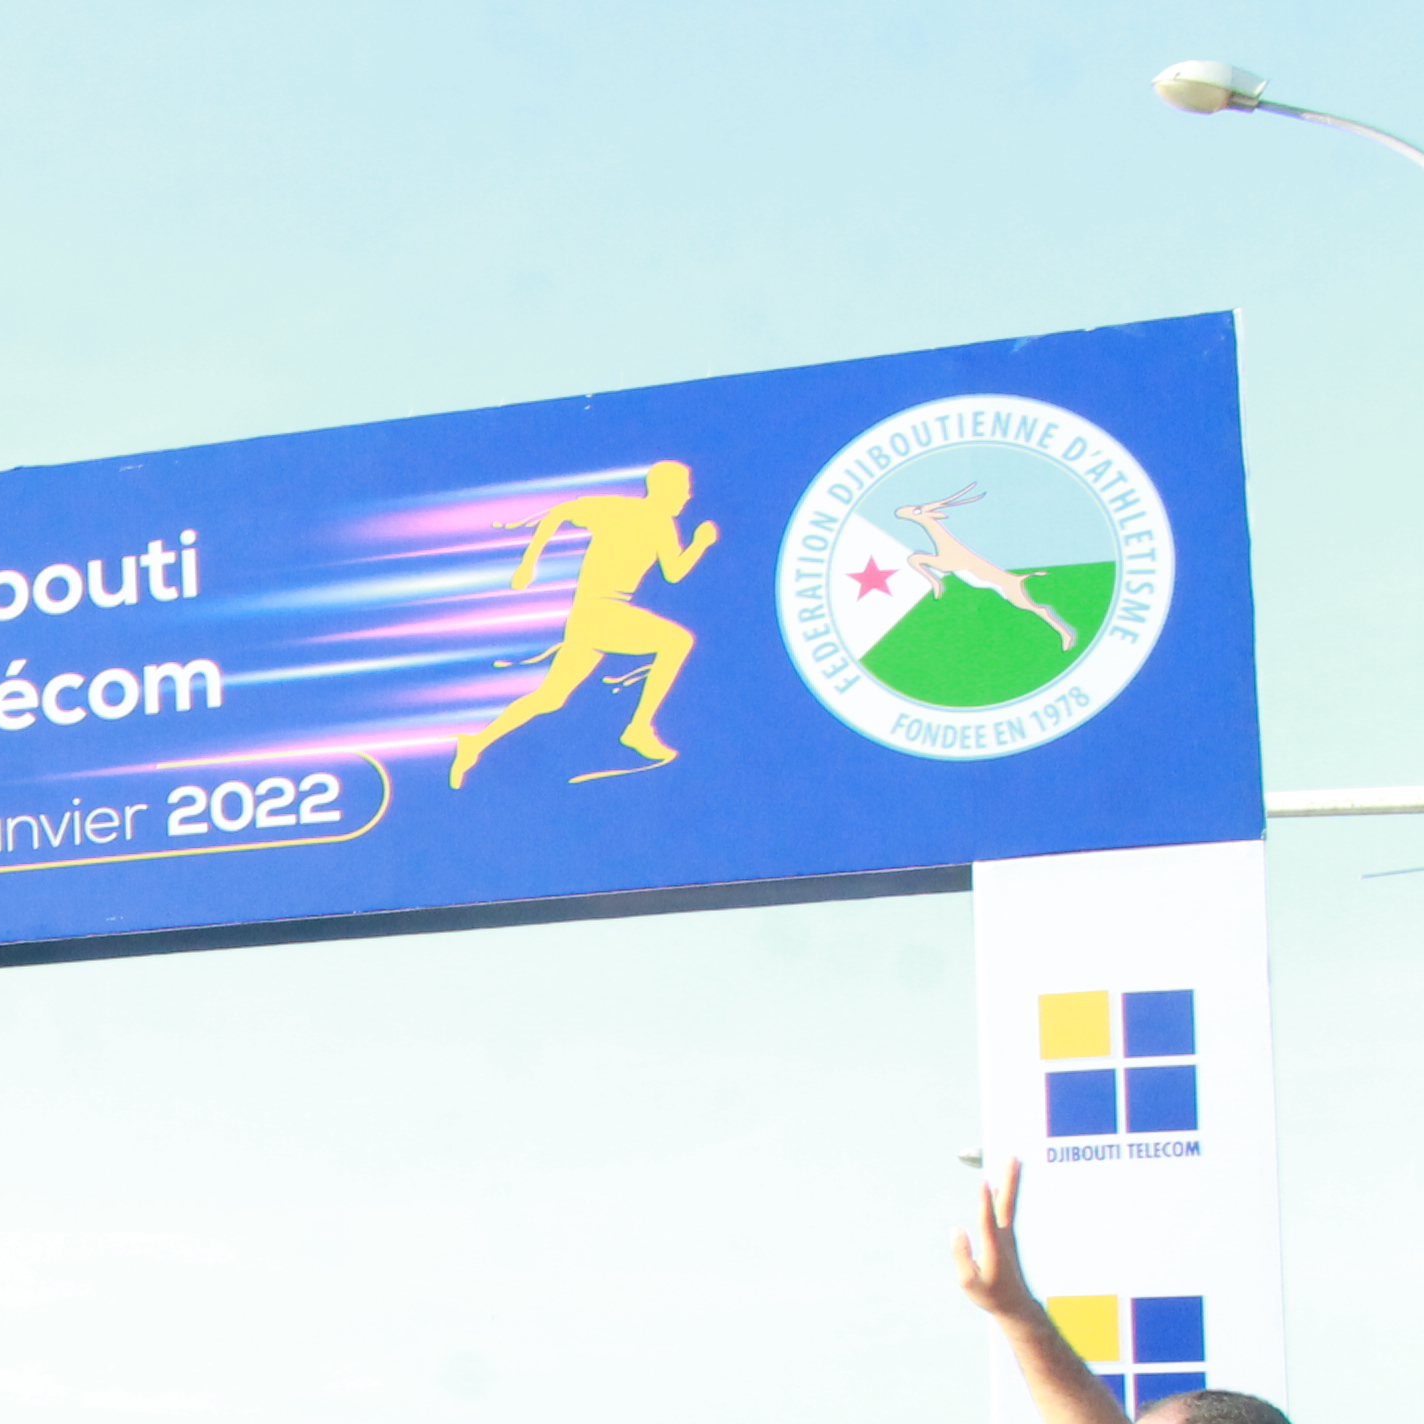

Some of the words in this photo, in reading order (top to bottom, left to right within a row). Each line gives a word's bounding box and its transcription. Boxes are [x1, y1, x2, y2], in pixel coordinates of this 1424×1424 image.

[794, 511, 861, 695] FEDERATION
[828, 409, 1060, 503] DJIBOUTIENNE
[1061, 434, 1157, 645] D'ATHLETISME
[890, 712, 988, 750] FONDEE
[993, 716, 1027, 747] EN
[1029, 686, 1092, 733] 1978
[166, 771, 342, 837] 2022
[1046, 1143, 1121, 1163] DJIBOUTI
[1127, 1140, 1201, 1159] TELECOM
